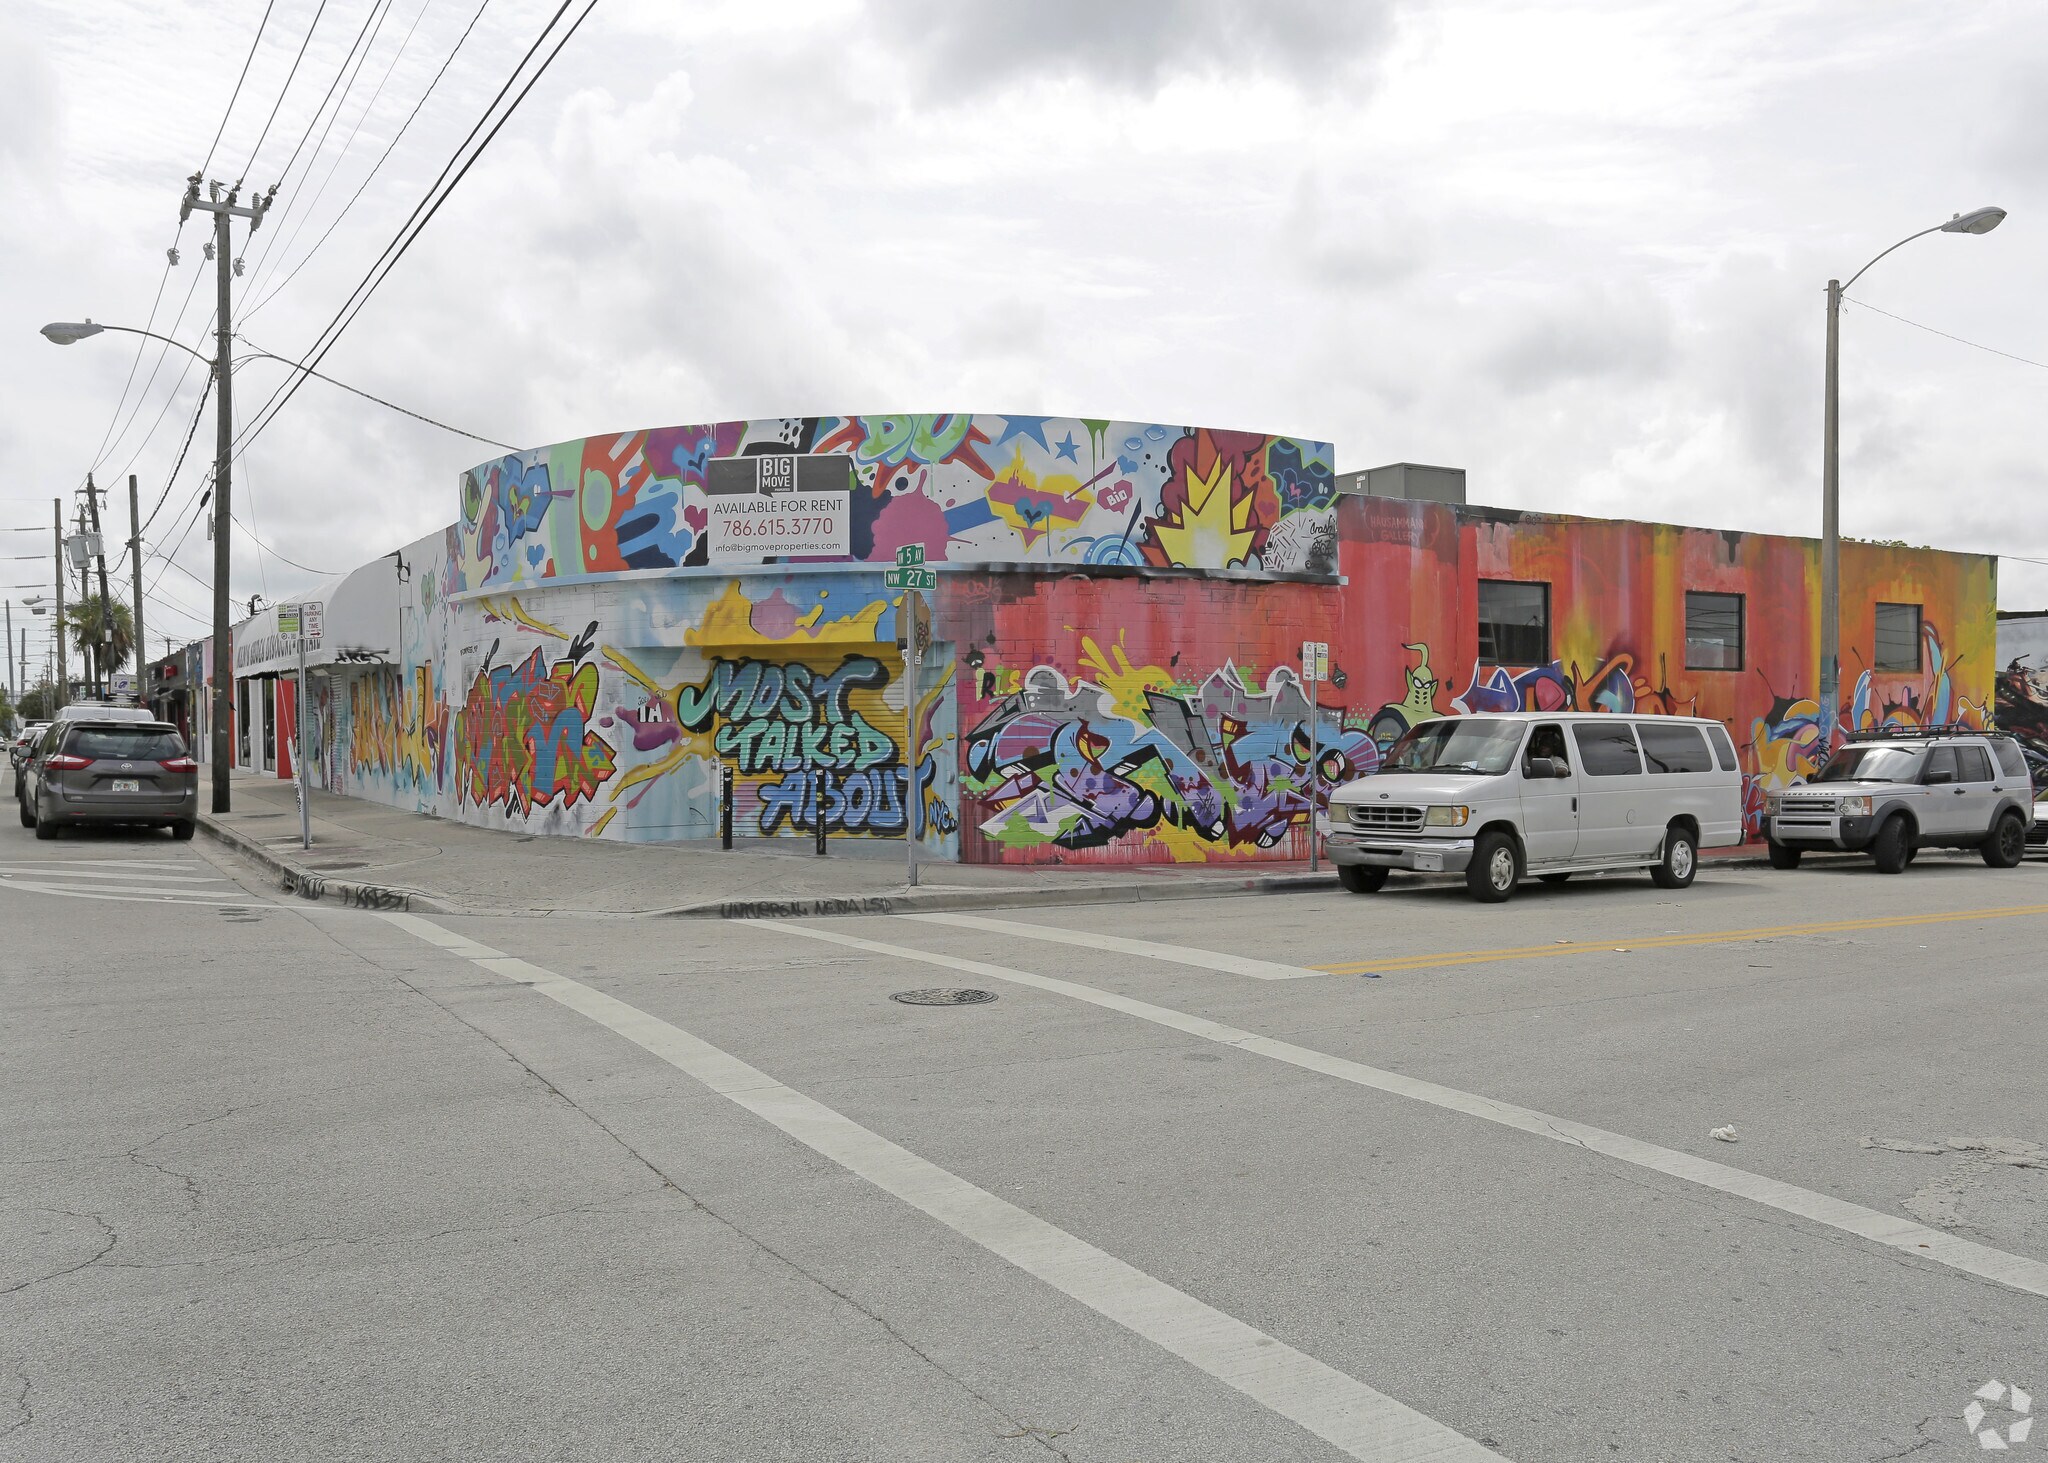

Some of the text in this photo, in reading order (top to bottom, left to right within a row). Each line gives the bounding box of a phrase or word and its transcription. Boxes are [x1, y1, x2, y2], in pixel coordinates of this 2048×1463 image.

[762, 457, 791, 476] BIG
[762, 476, 791, 488] MOVE
[713, 499, 843, 515] AVAILABLE FOR RENT
[723, 517, 833, 537] 786.615.3770
[715, 542, 841, 553] info@bigmoveproperties.com
[906, 548, 912, 564] 5
[887, 569, 934, 587] NW 27 ST
[678, 653, 890, 734] MOST
[715, 710, 901, 776] TALKED
[757, 752, 937, 842] ABOUT
